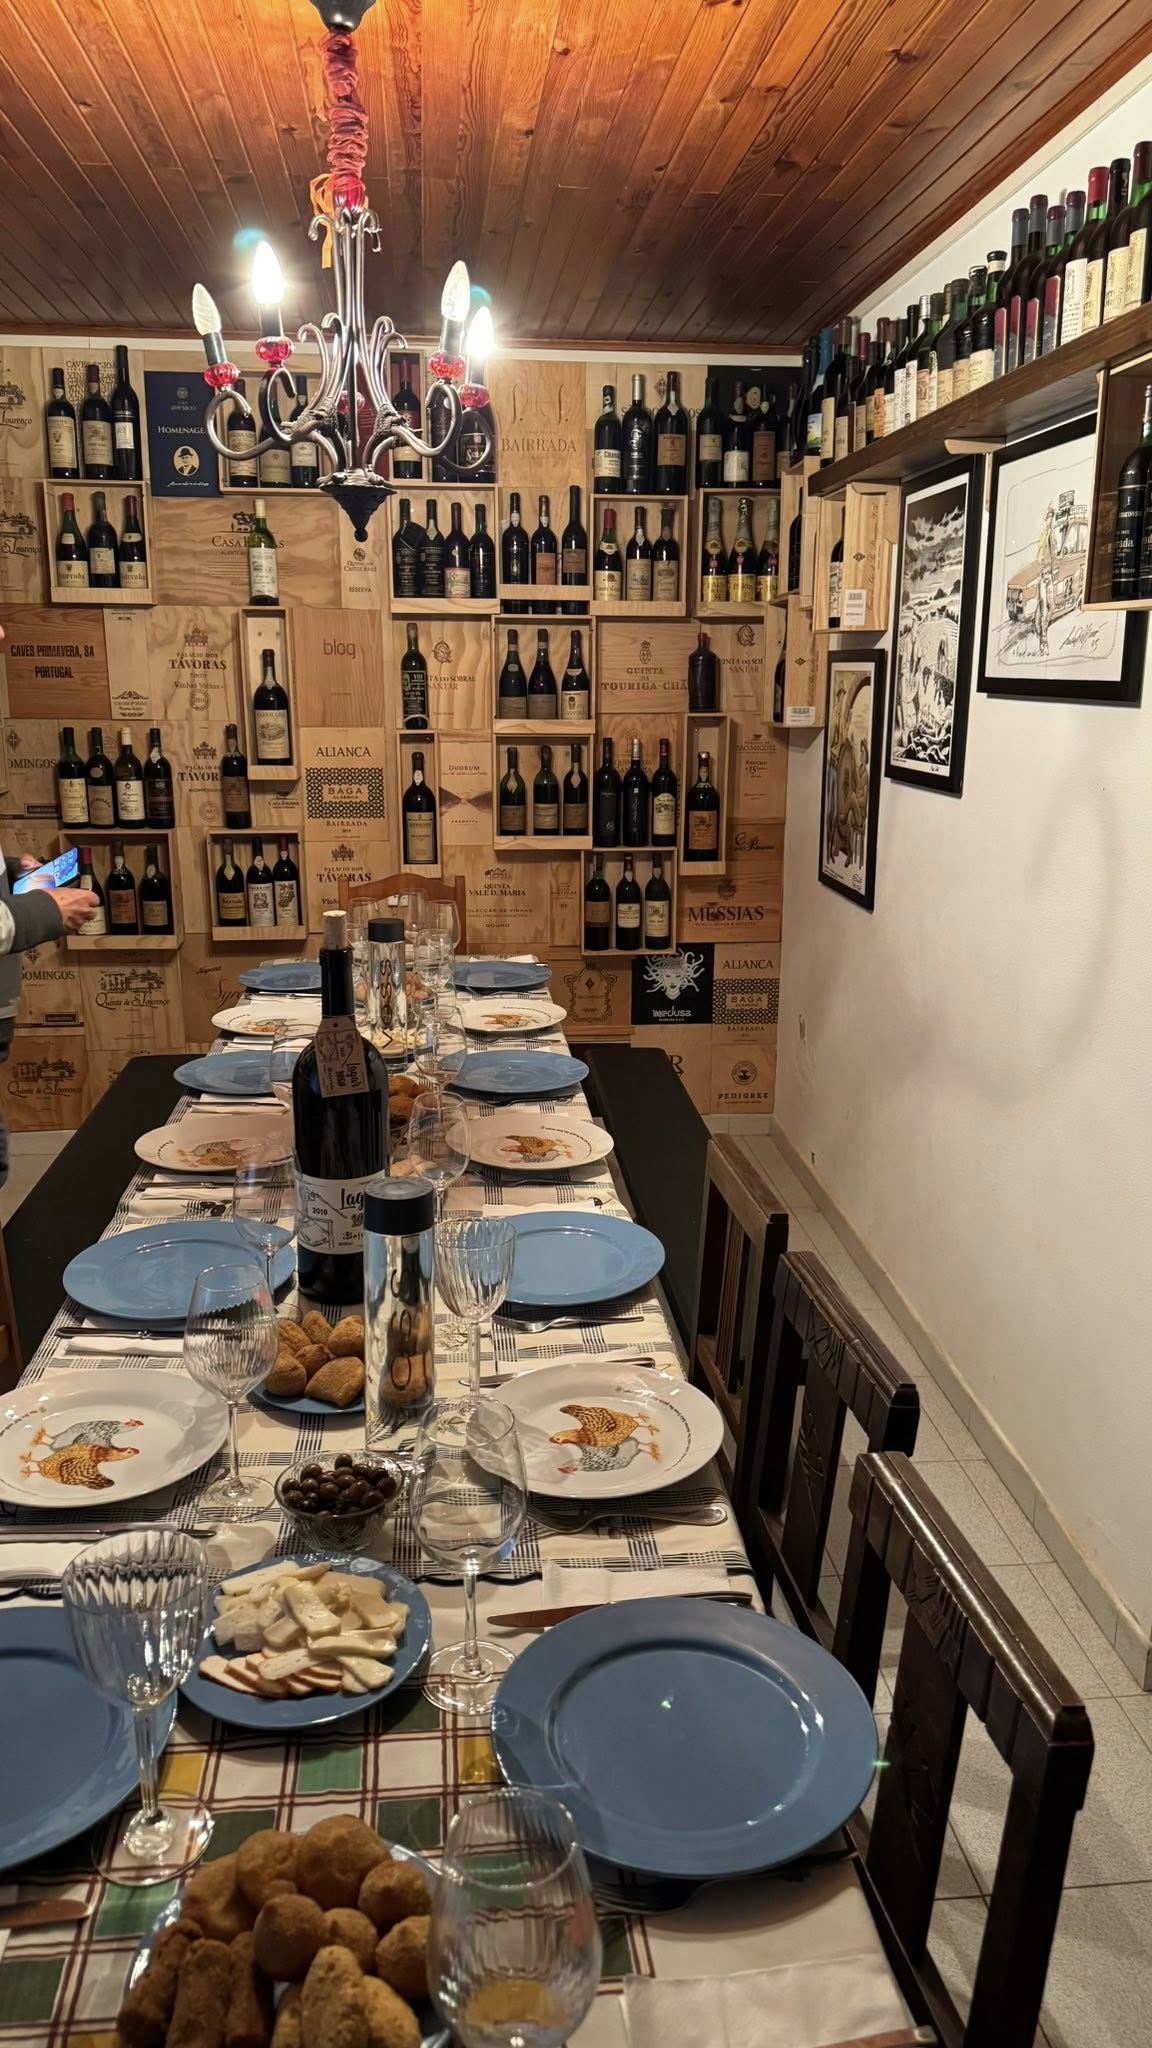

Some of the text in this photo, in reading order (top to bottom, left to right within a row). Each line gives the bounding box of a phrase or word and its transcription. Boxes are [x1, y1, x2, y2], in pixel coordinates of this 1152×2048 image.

[502, 438, 576, 452] BAIRRADA
[212, 536, 242, 548] CASA
[11, 645, 94, 659] CAVES PRIMAVERA, SA
[323, 638, 356, 659] blog
[169, 658, 227, 670] TÁVORAS
[35, 666, 73, 678] PORTUGAL
[688, 906, 764, 921] MESSIAS
[652, 1005, 692, 1017] medusa
